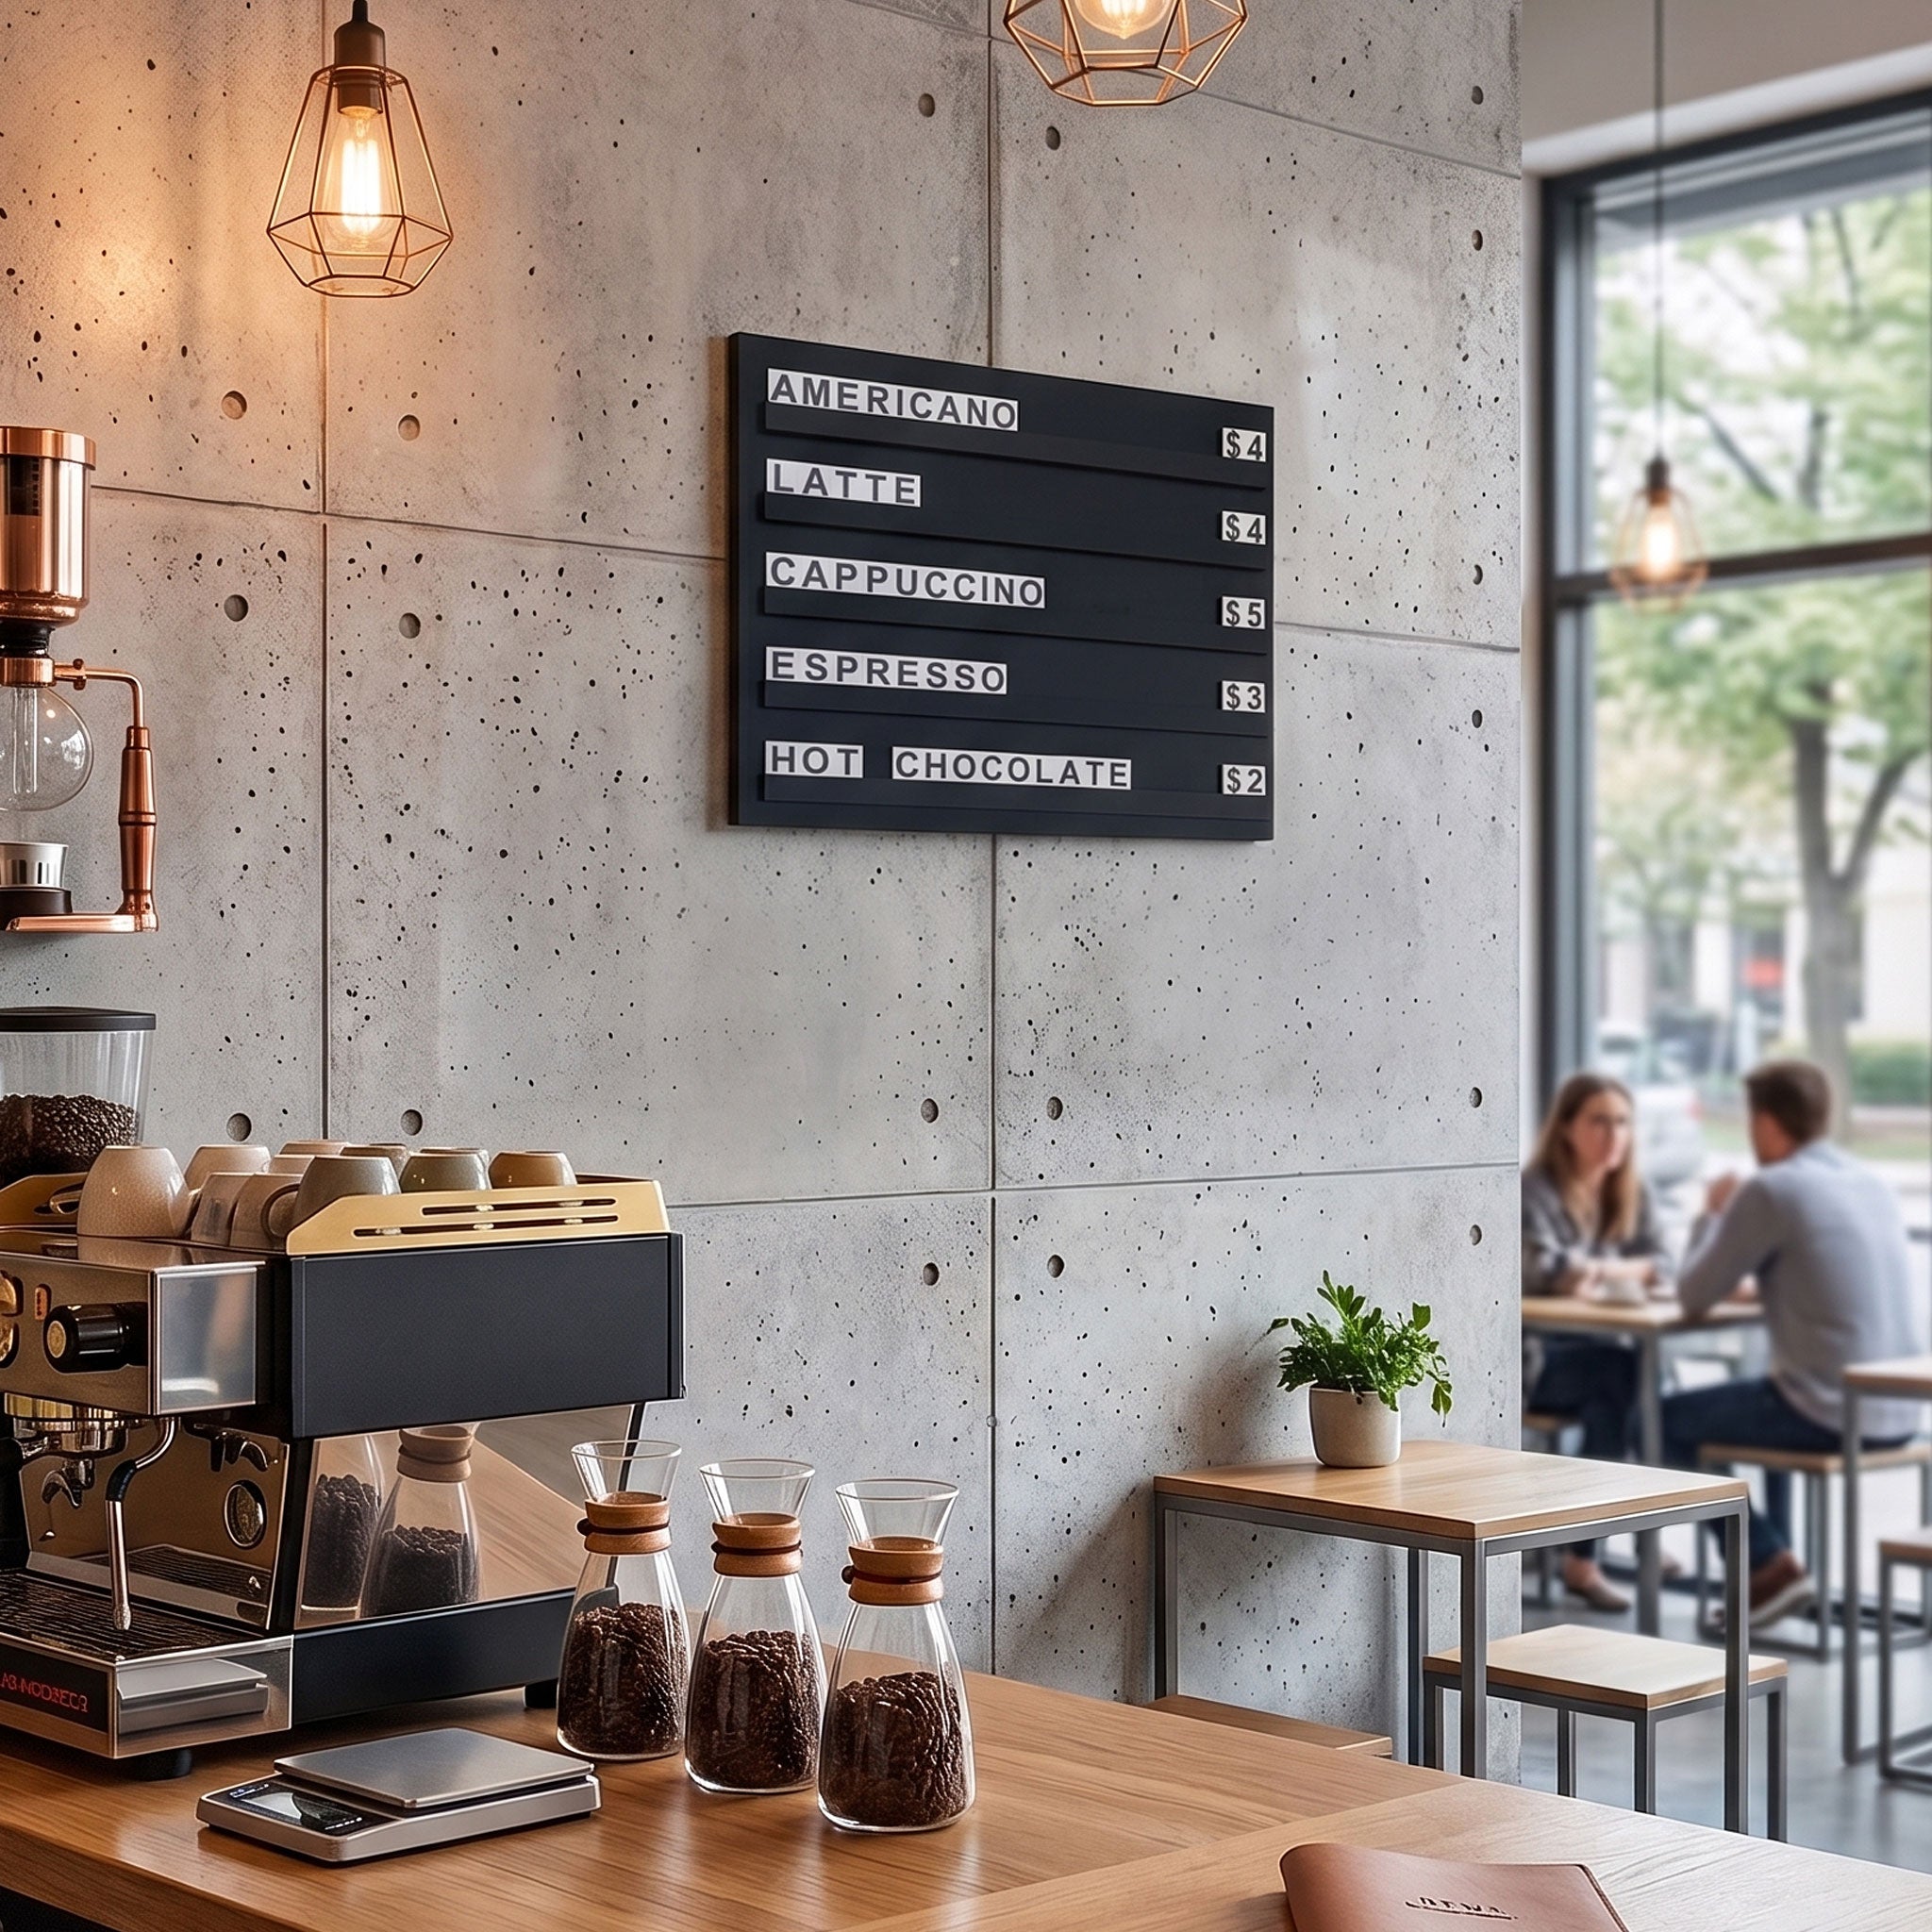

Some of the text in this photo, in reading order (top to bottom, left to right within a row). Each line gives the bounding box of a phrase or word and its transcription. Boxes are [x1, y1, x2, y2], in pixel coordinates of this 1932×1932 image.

[770, 374, 1263, 460] AMERICANO $4
[774, 463, 1263, 543] LATTE $4
[770, 557, 1262, 628] CAPPUCCINO $5
[772, 651, 1262, 710] ESPRESSO $3
[772, 744, 1263, 794] HOT CHOCOLATE $2
